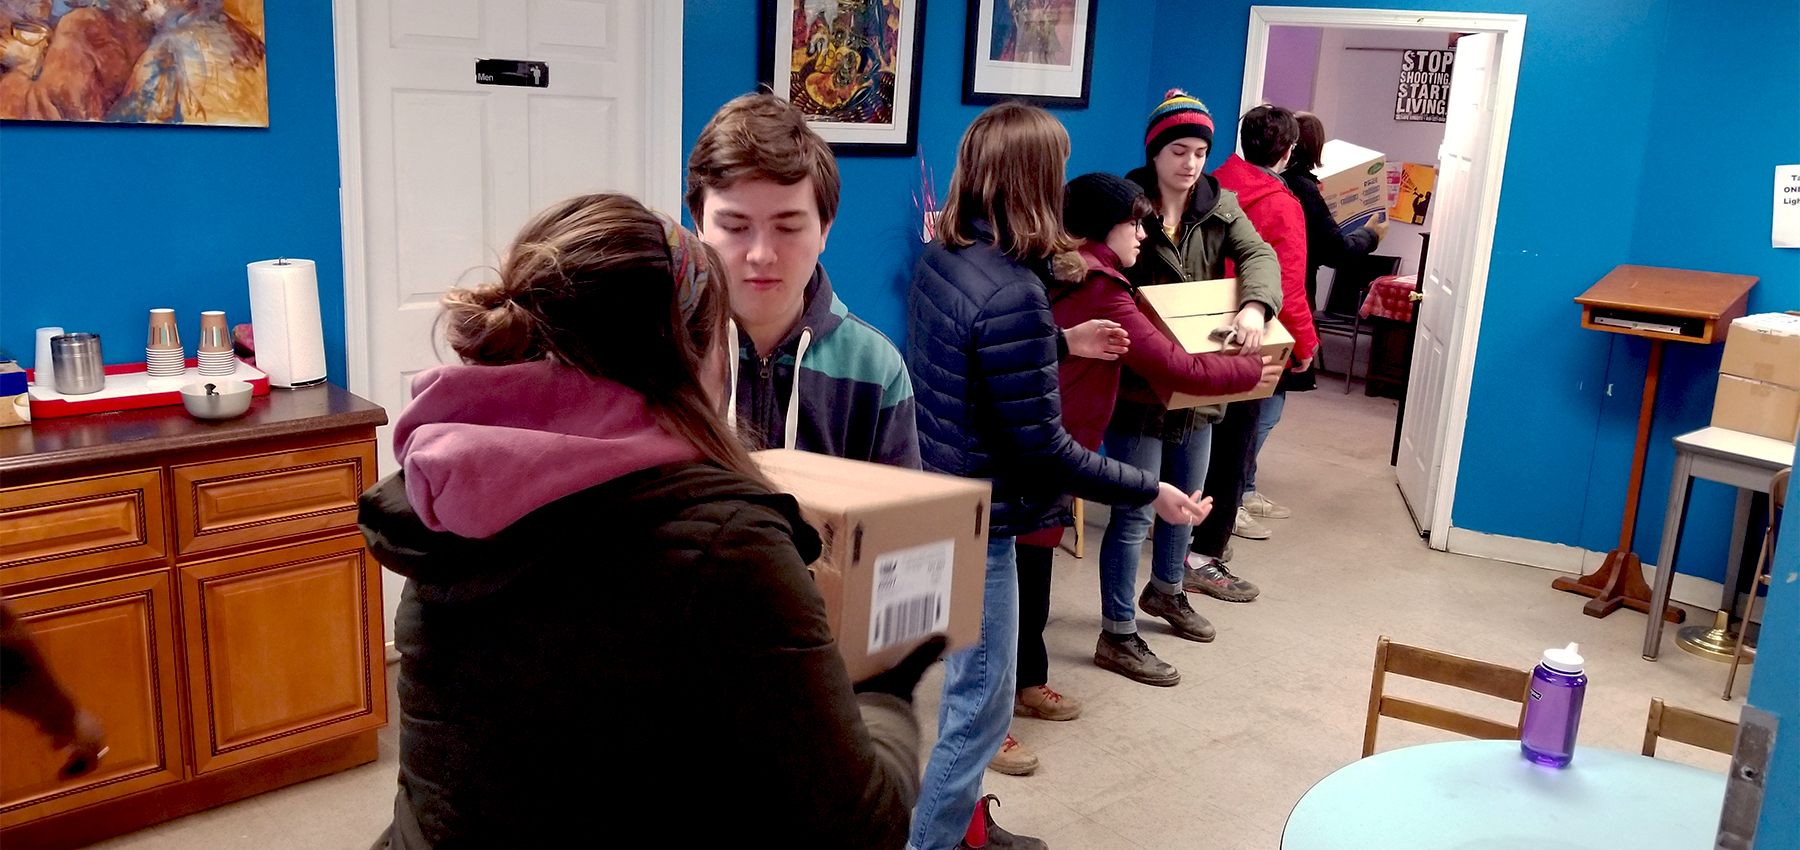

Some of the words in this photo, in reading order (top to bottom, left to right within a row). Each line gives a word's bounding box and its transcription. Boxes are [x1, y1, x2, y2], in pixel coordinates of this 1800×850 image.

[1402, 50, 1454, 73] STOP
[477, 73, 494, 81] Men
[1400, 71, 1451, 85] SHOOTING.
[1398, 83, 1449, 101] START
[1396, 97, 1447, 115] LIVING.
